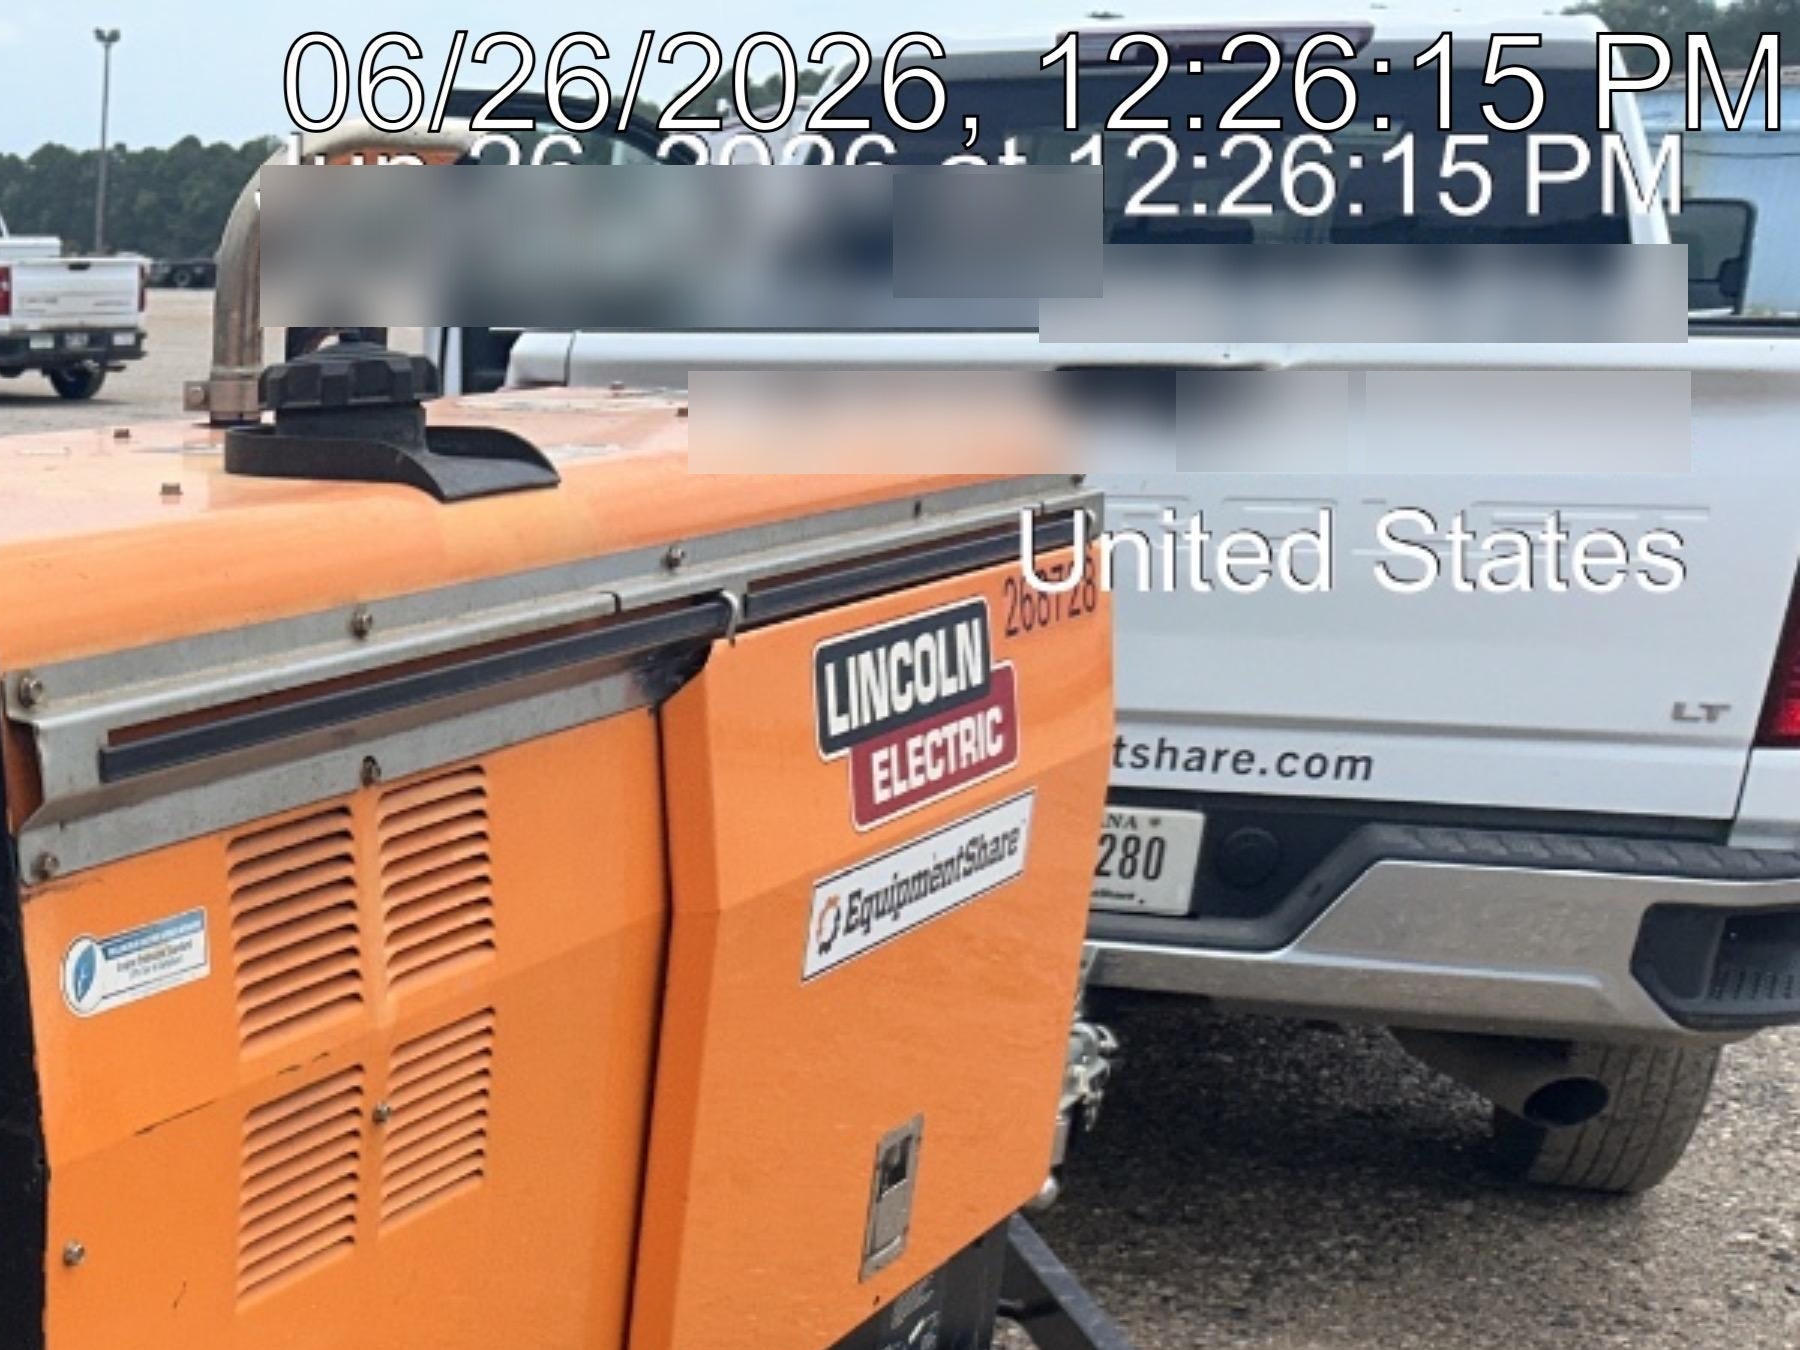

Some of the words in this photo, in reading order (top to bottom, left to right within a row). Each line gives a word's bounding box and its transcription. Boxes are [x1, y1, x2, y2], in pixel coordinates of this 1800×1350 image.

[824, 618, 983, 737] LINCOLN
[1672, 702, 1731, 724] LT
[870, 706, 1003, 805] ELECTRIC
[841, 826, 1021, 940] EquipmentShare
